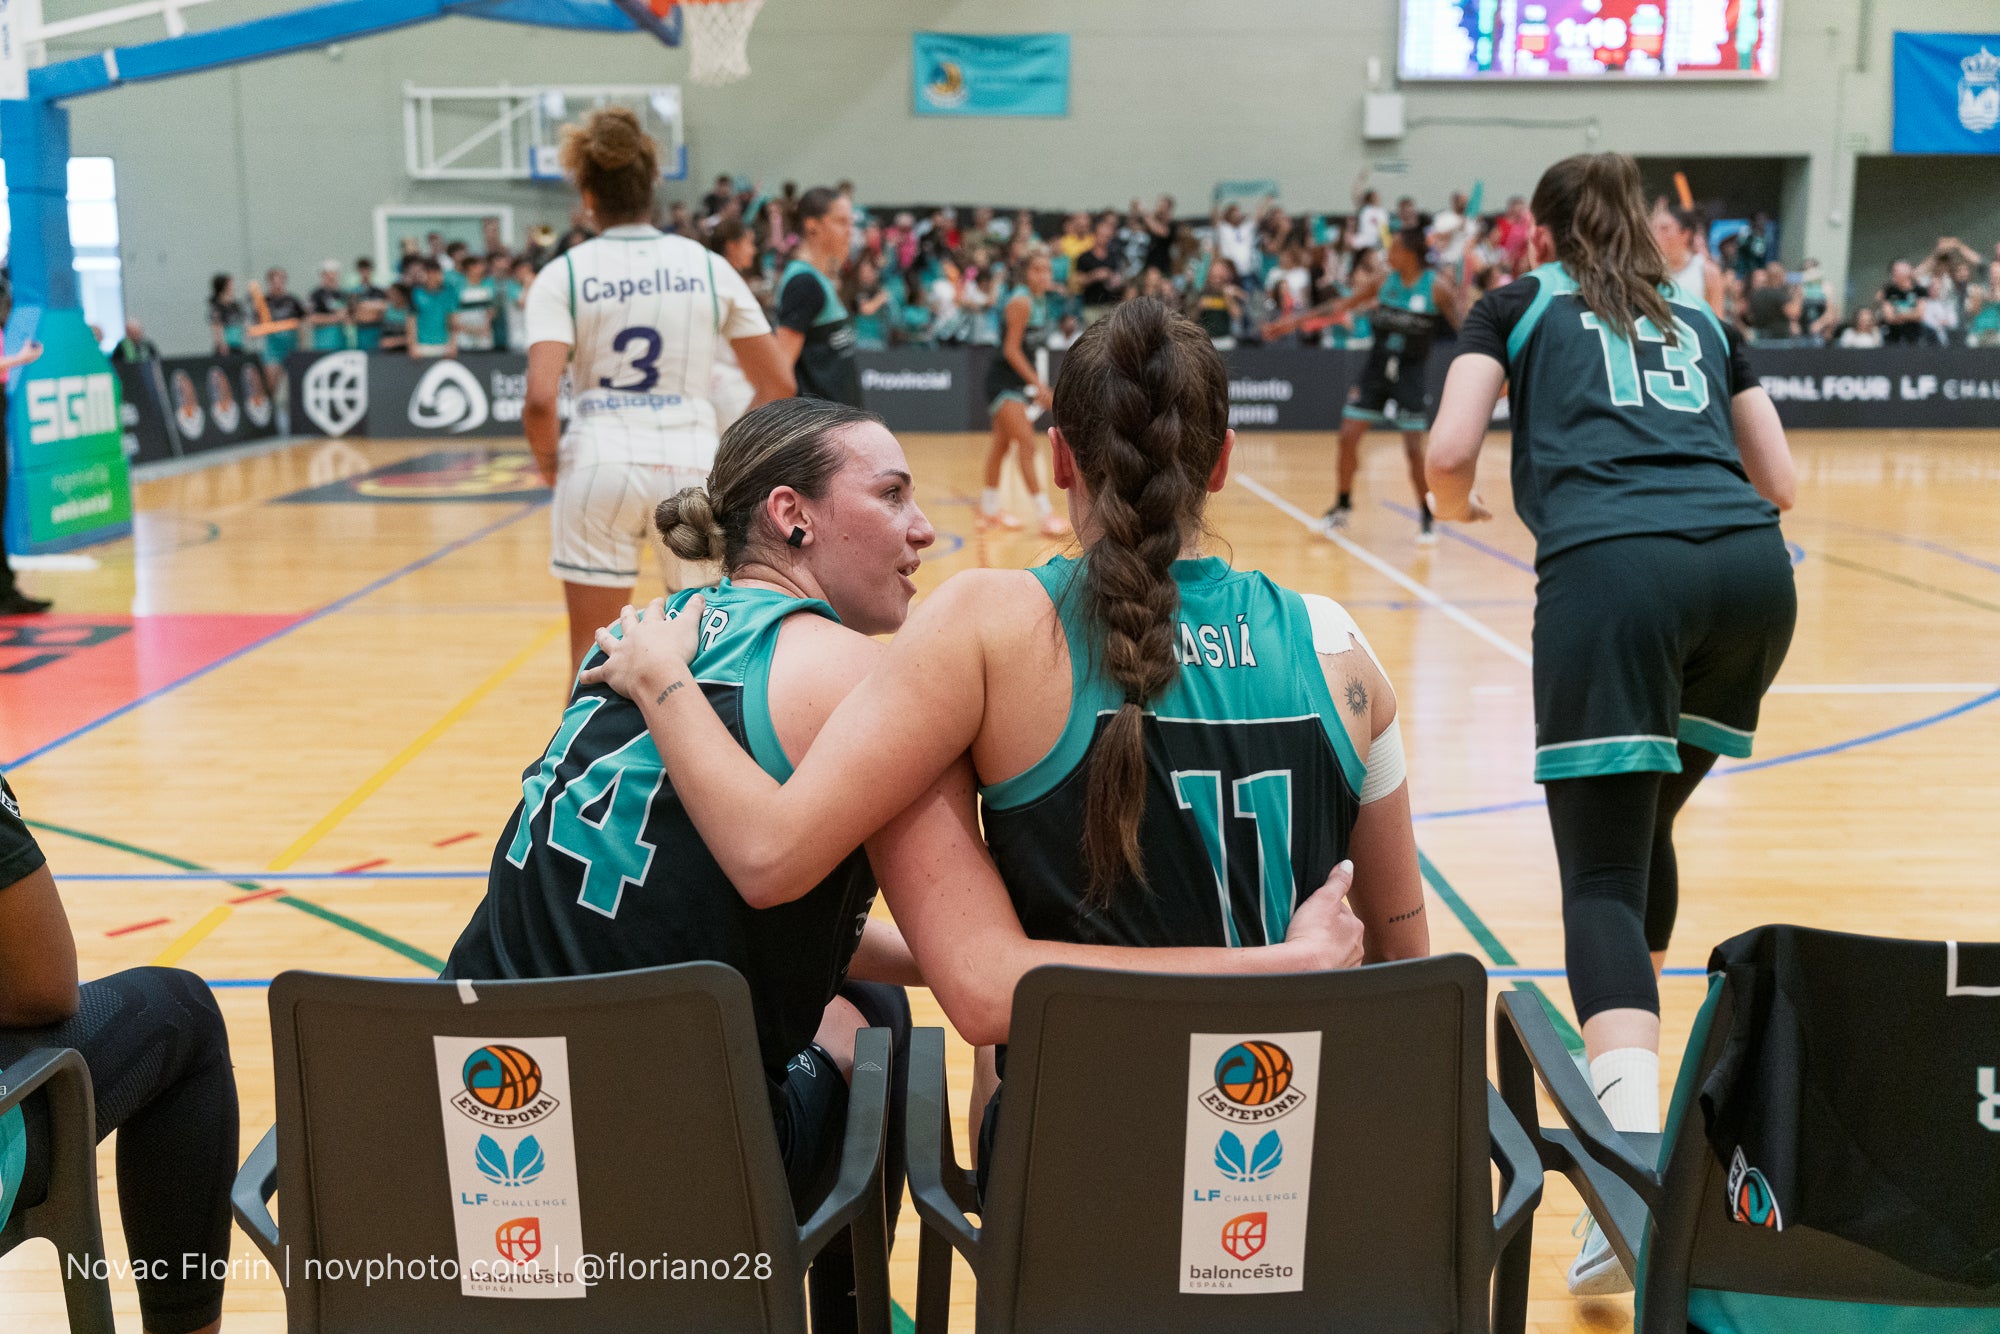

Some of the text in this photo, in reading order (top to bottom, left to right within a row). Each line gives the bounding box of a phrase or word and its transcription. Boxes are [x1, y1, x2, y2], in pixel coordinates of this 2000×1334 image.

[582, 269, 705, 302] Capellán
[599, 326, 663, 393] 3
[1580, 312, 1710, 414] 13
[861, 368, 952, 391] Provincial
[1822, 375, 1891, 400] FOUR
[1900, 375, 1938, 400] LF
[1171, 612, 1258, 668] ASIÁ
[506, 695, 666, 919] 14
[1171, 769, 1297, 948] 11
[458, 1096, 552, 1125] ESTEPONA
[1205, 1093, 1299, 1120] ESTEPONA
[461, 1192, 567, 1207] LF CHALLENGE
[1193, 1189, 1298, 1203] LF CHALLENGE
[1190, 1263, 1294, 1279] baloncesto
